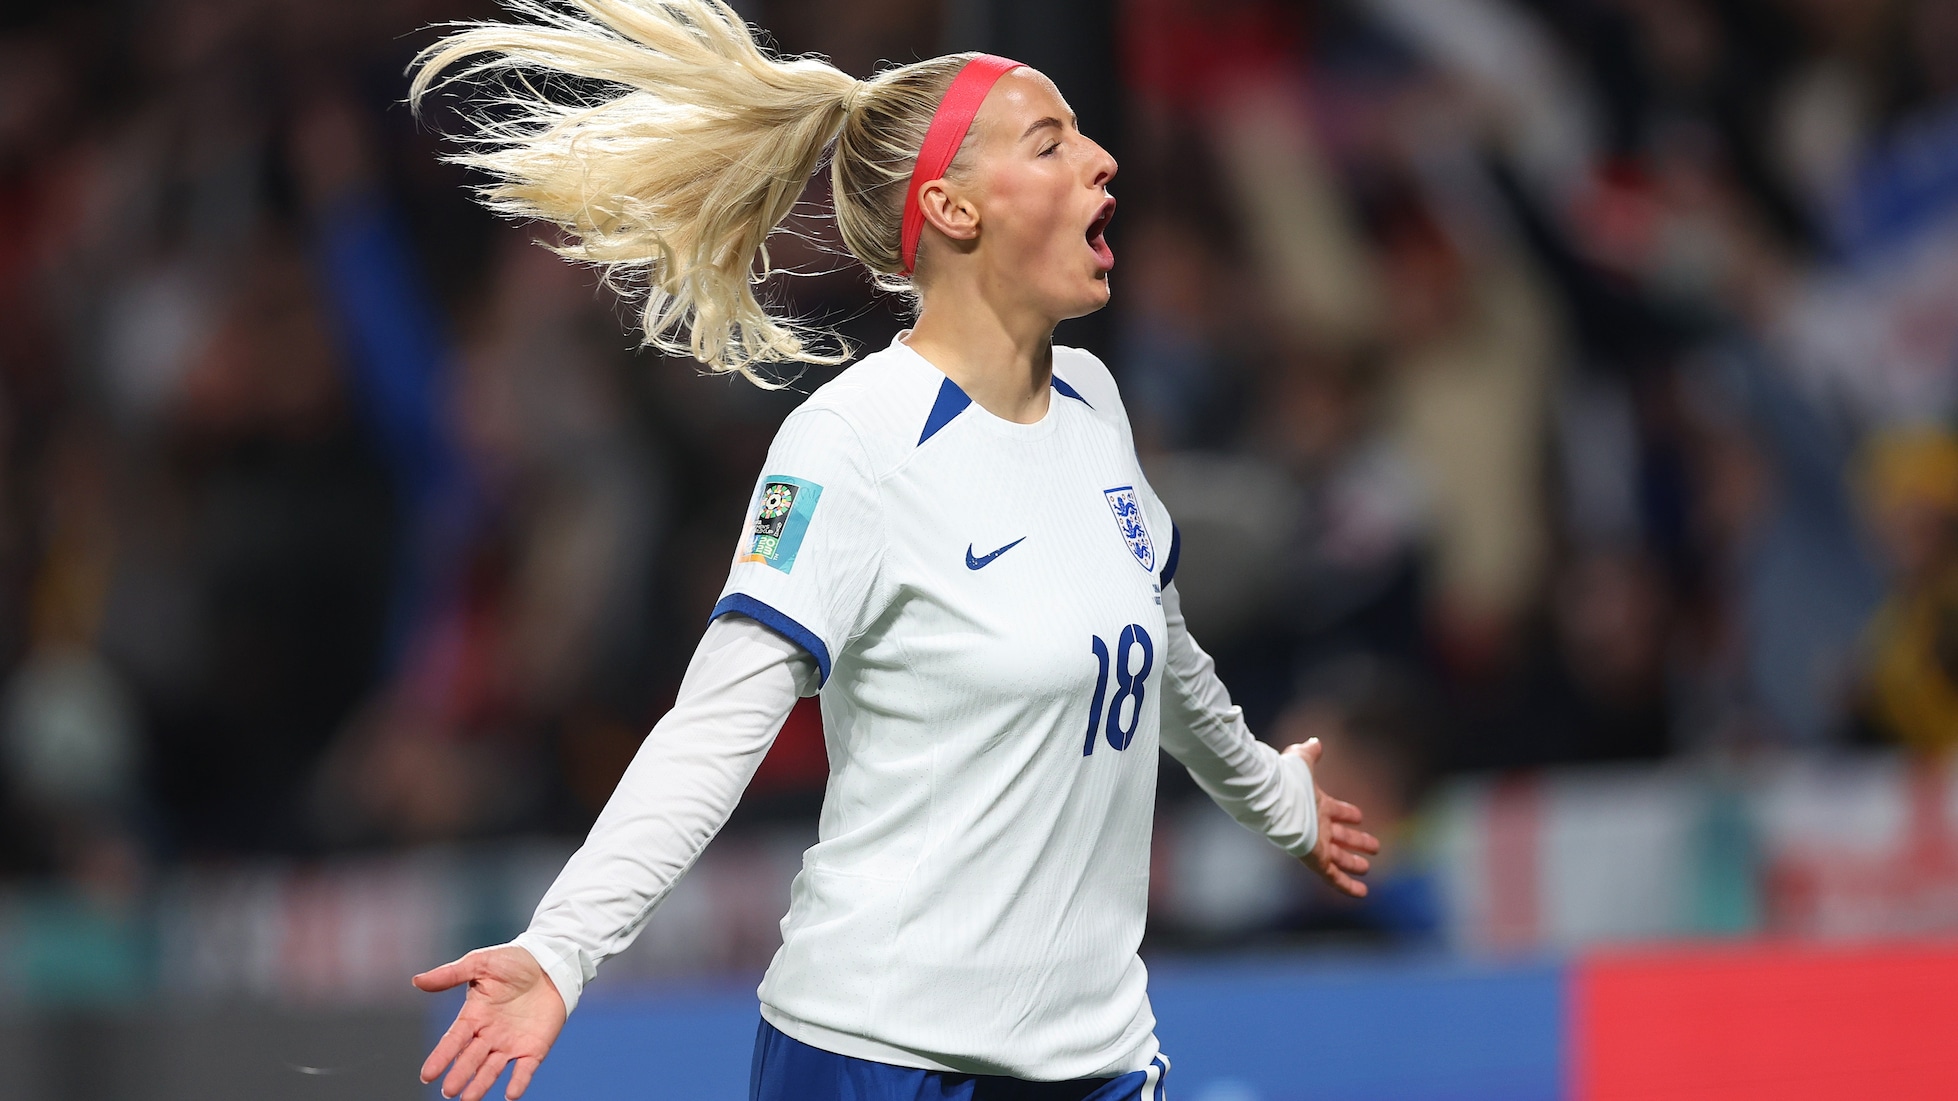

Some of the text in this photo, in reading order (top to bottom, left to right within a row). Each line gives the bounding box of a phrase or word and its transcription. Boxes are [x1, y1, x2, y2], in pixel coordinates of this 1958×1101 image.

[758, 537, 775, 547] 20
[755, 545, 772, 555] 23
[1083, 623, 1154, 757] 18
